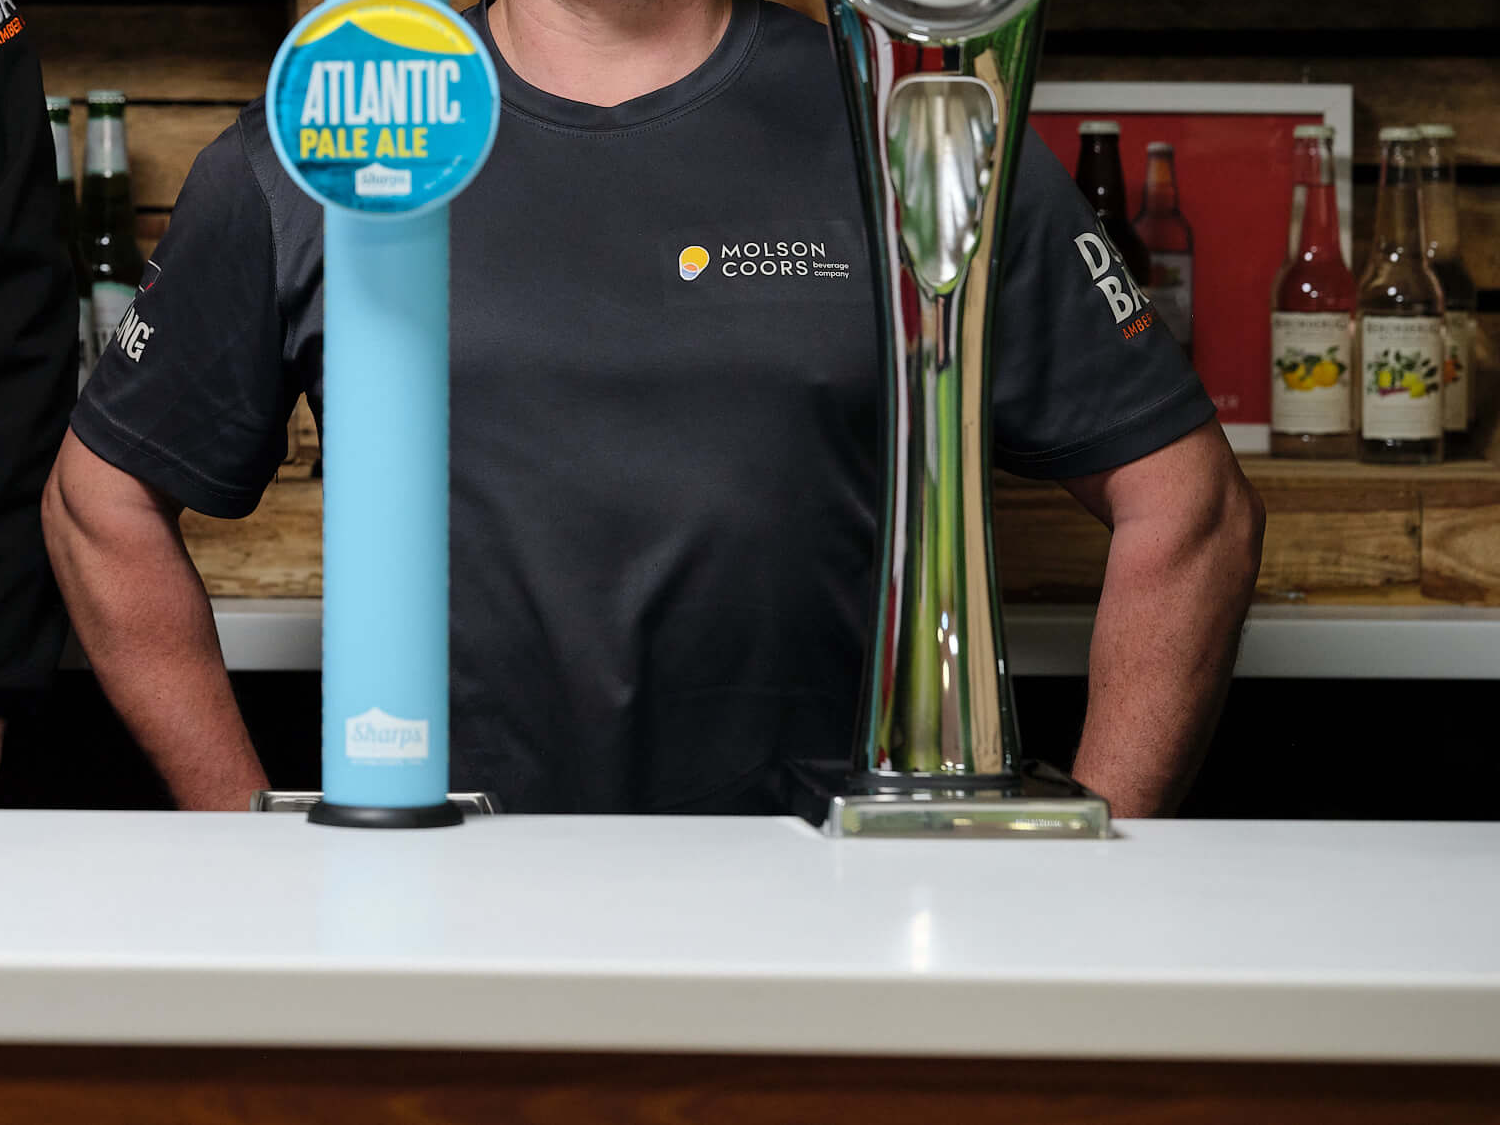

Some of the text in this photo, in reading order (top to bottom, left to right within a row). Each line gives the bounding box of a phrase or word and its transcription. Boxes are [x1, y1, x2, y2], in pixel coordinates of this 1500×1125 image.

[301, 59, 462, 125] ATLANTIC
[300, 127, 428, 159] PALE ALE
[721, 242, 826, 259] MOLSON
[722, 260, 808, 277] COORS
[812, 261, 849, 270] beverage
[814, 270, 850, 279] company
